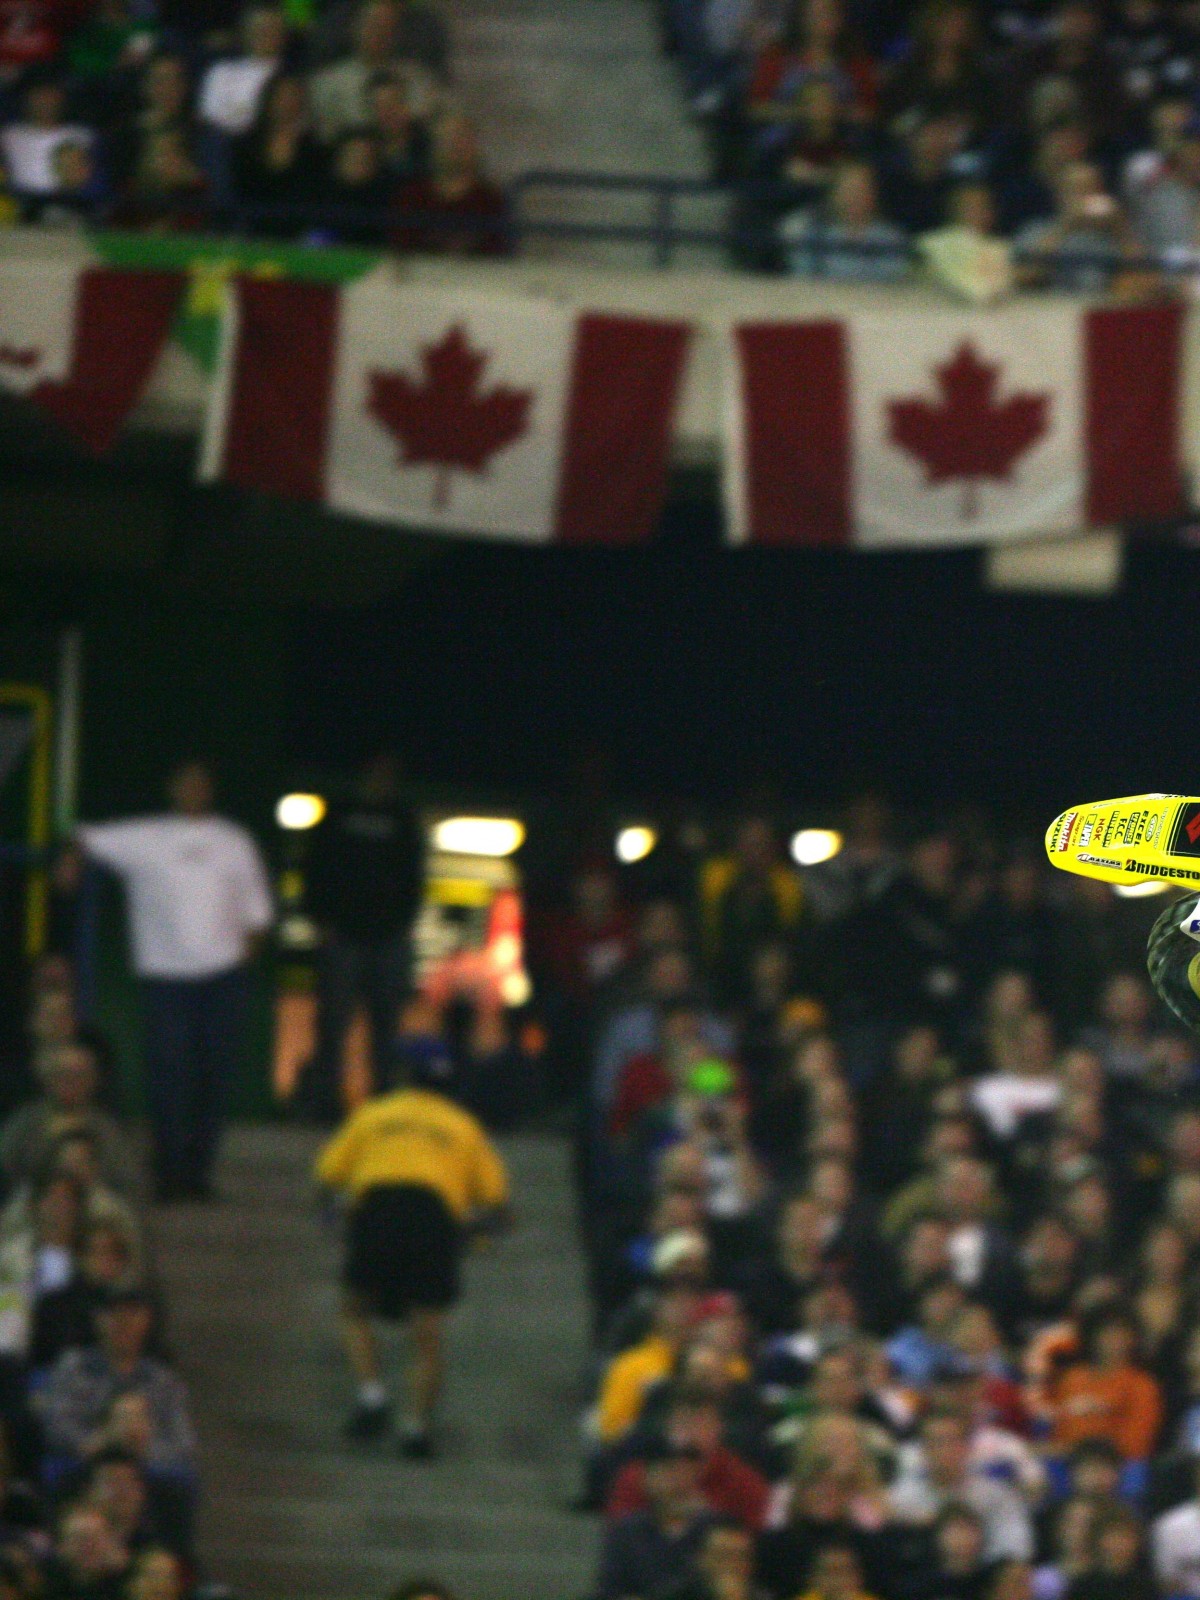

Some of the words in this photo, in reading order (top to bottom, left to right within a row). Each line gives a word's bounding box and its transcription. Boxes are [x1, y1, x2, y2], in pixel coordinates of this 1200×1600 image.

[1050, 813, 1067, 853] SUZUKI
[1093, 818, 1106, 841] NGK
[1134, 810, 1149, 847] EXCEL
